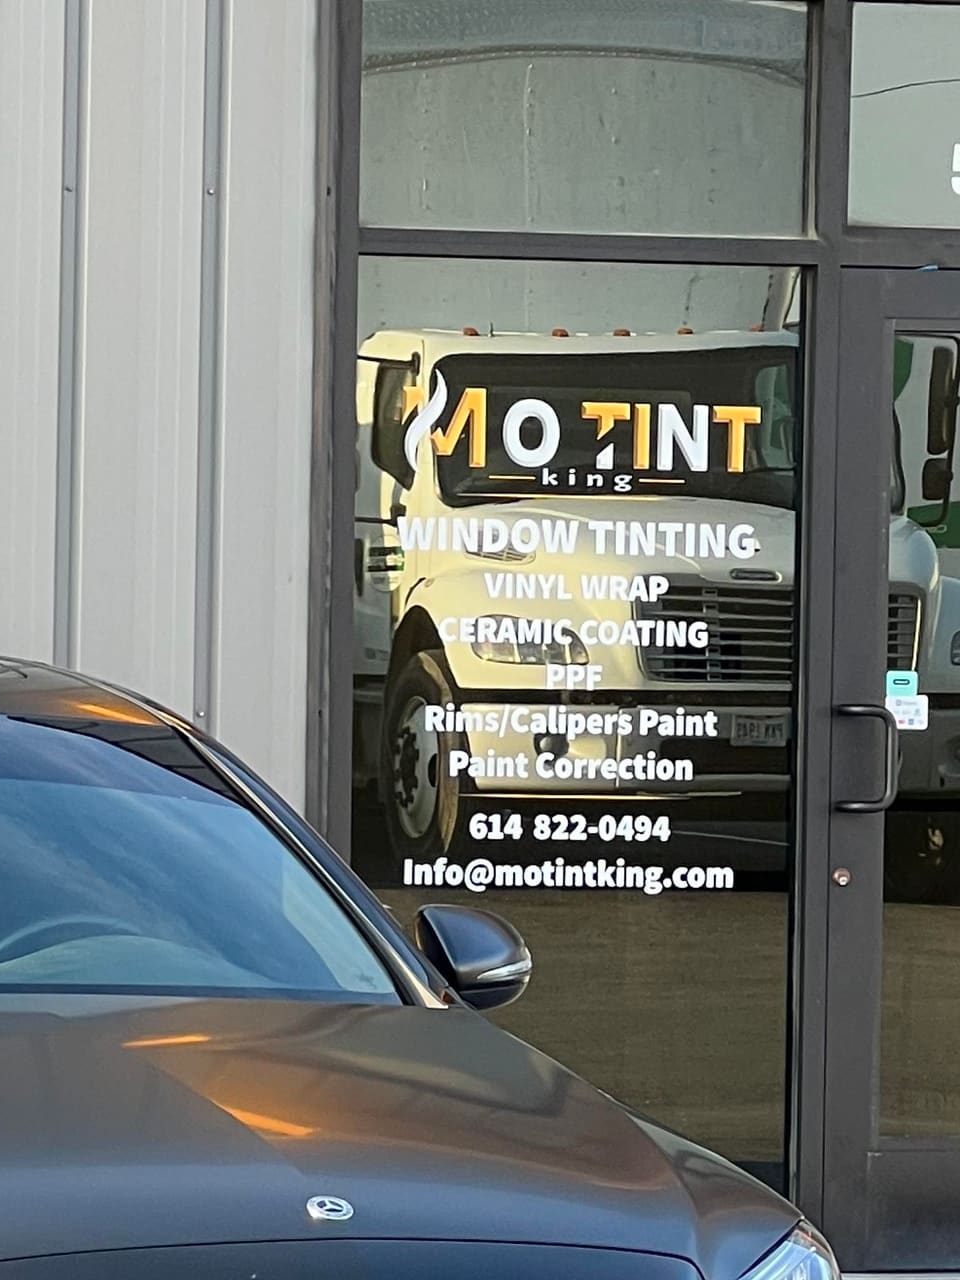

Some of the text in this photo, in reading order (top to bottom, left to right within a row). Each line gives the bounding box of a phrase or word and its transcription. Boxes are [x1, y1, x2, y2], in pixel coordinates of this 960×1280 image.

[581, 401, 761, 472] TINT
[542, 469, 632, 492] king
[398, 517, 757, 559] WINDOW TINTING
[484, 573, 669, 602] VINYL WRAP
[439, 617, 709, 648] CERAMIC COATING
[546, 664, 602, 691] PPF
[424, 705, 633, 741] Rims/Calipers
[639, 709, 718, 736] Paint
[449, 750, 693, 781] Paint Correction
[469, 814, 670, 842] 614 822-0494
[404, 858, 734, 894] Info@motintking.com
